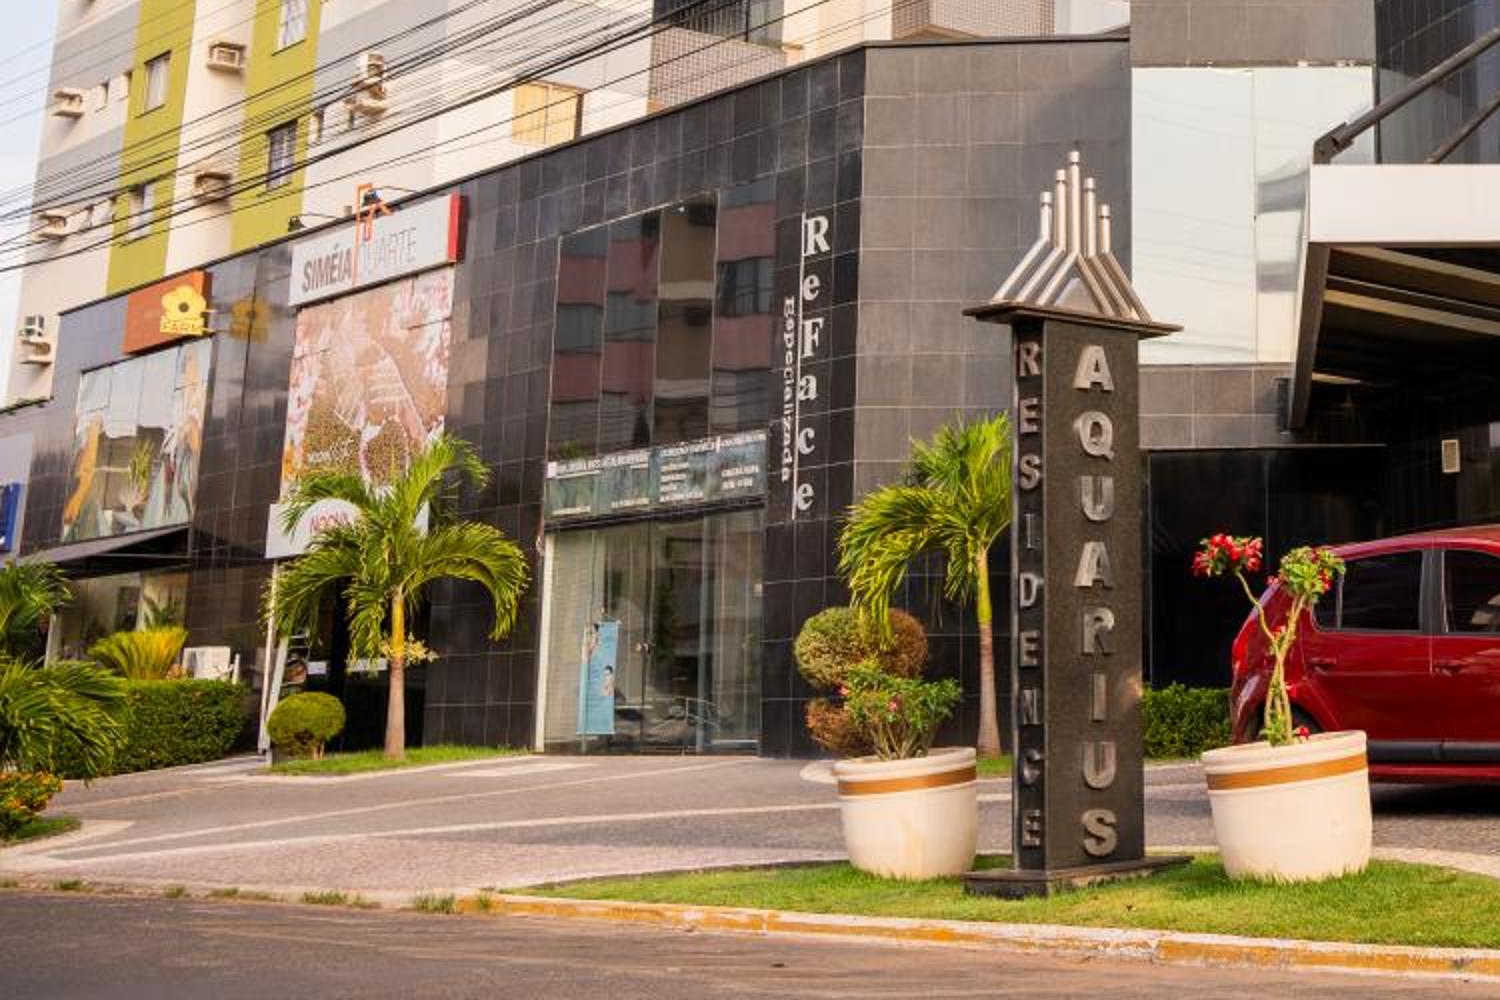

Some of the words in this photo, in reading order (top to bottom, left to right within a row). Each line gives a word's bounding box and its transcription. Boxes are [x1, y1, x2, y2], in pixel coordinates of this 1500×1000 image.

[302, 242, 352, 294] SIMÉIA
[781, 295, 796, 483] Especializada
[798, 215, 831, 511] ReFace
[1018, 340, 1043, 849] RESIDENCE
[1072, 344, 1118, 857] AQUARIUS
